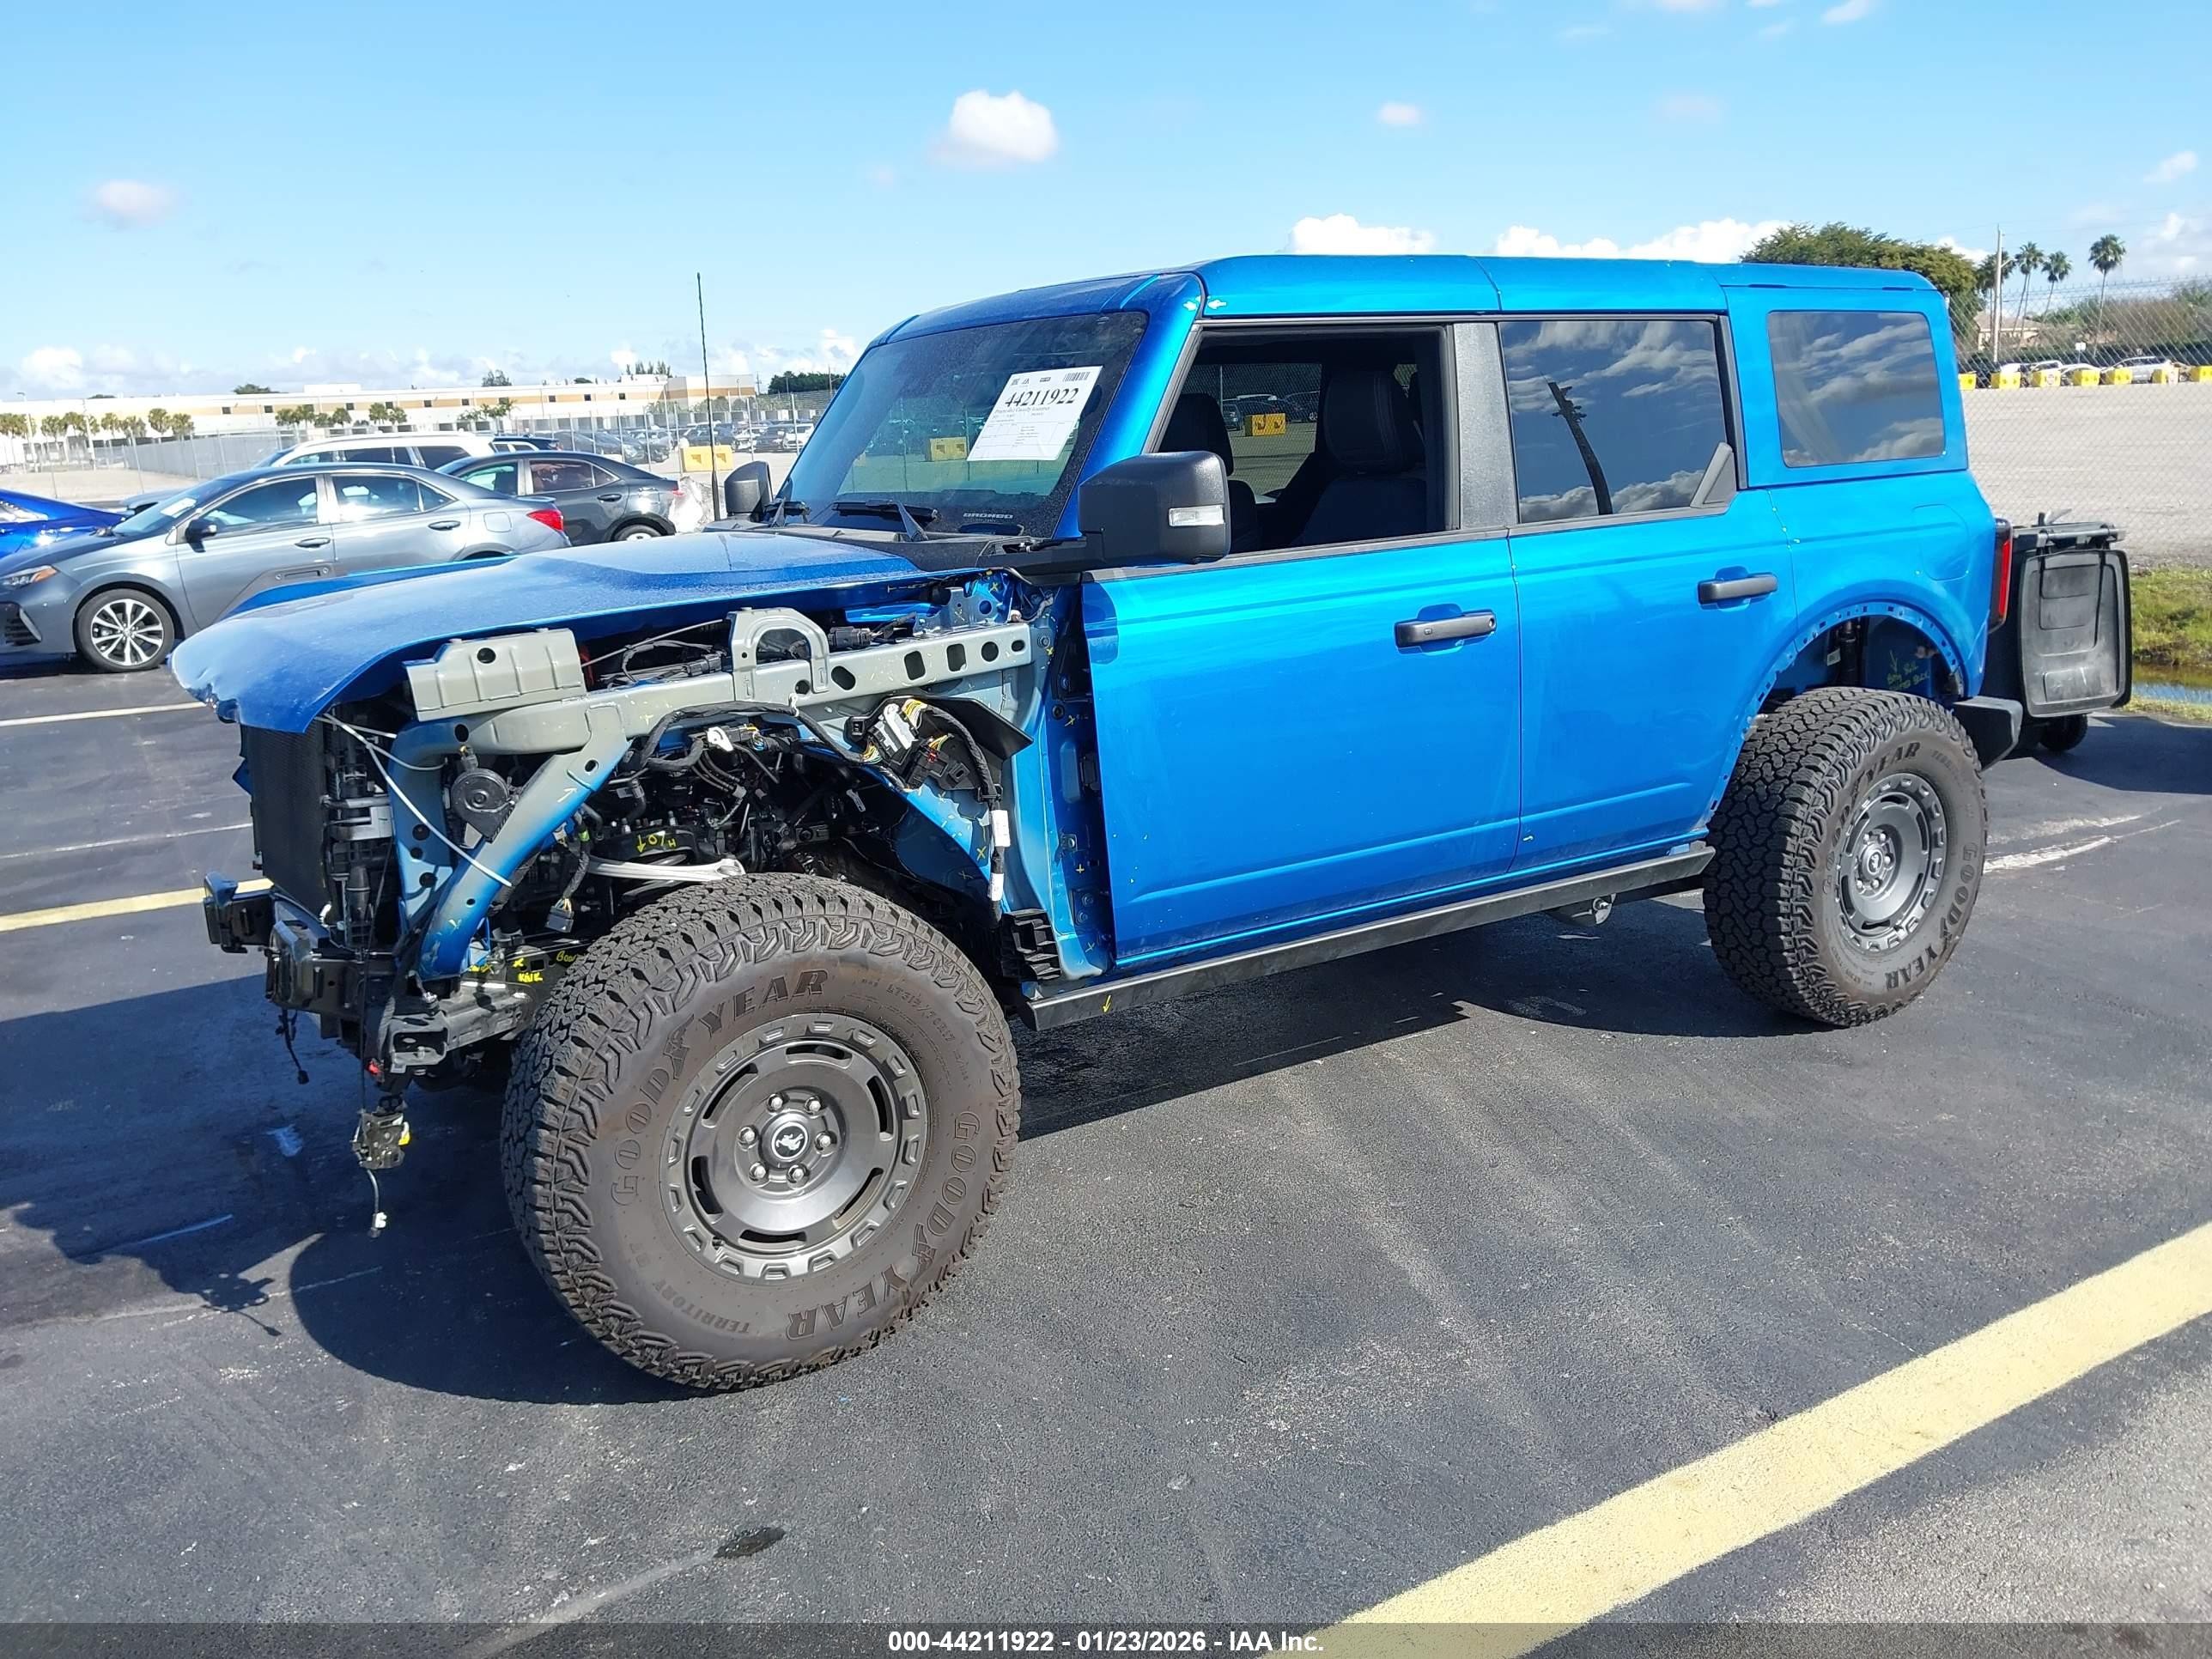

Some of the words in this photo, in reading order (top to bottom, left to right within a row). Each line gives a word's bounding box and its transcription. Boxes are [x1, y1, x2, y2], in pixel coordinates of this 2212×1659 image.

[1005, 387, 1079, 407] 44211922
[1884, 842, 1978, 989] GOODYEAR
[611, 969, 830, 1206] GOODYEAR
[786, 1111, 981, 1340] GOODYEAR
[652, 1279, 750, 1333] TERRITORY
